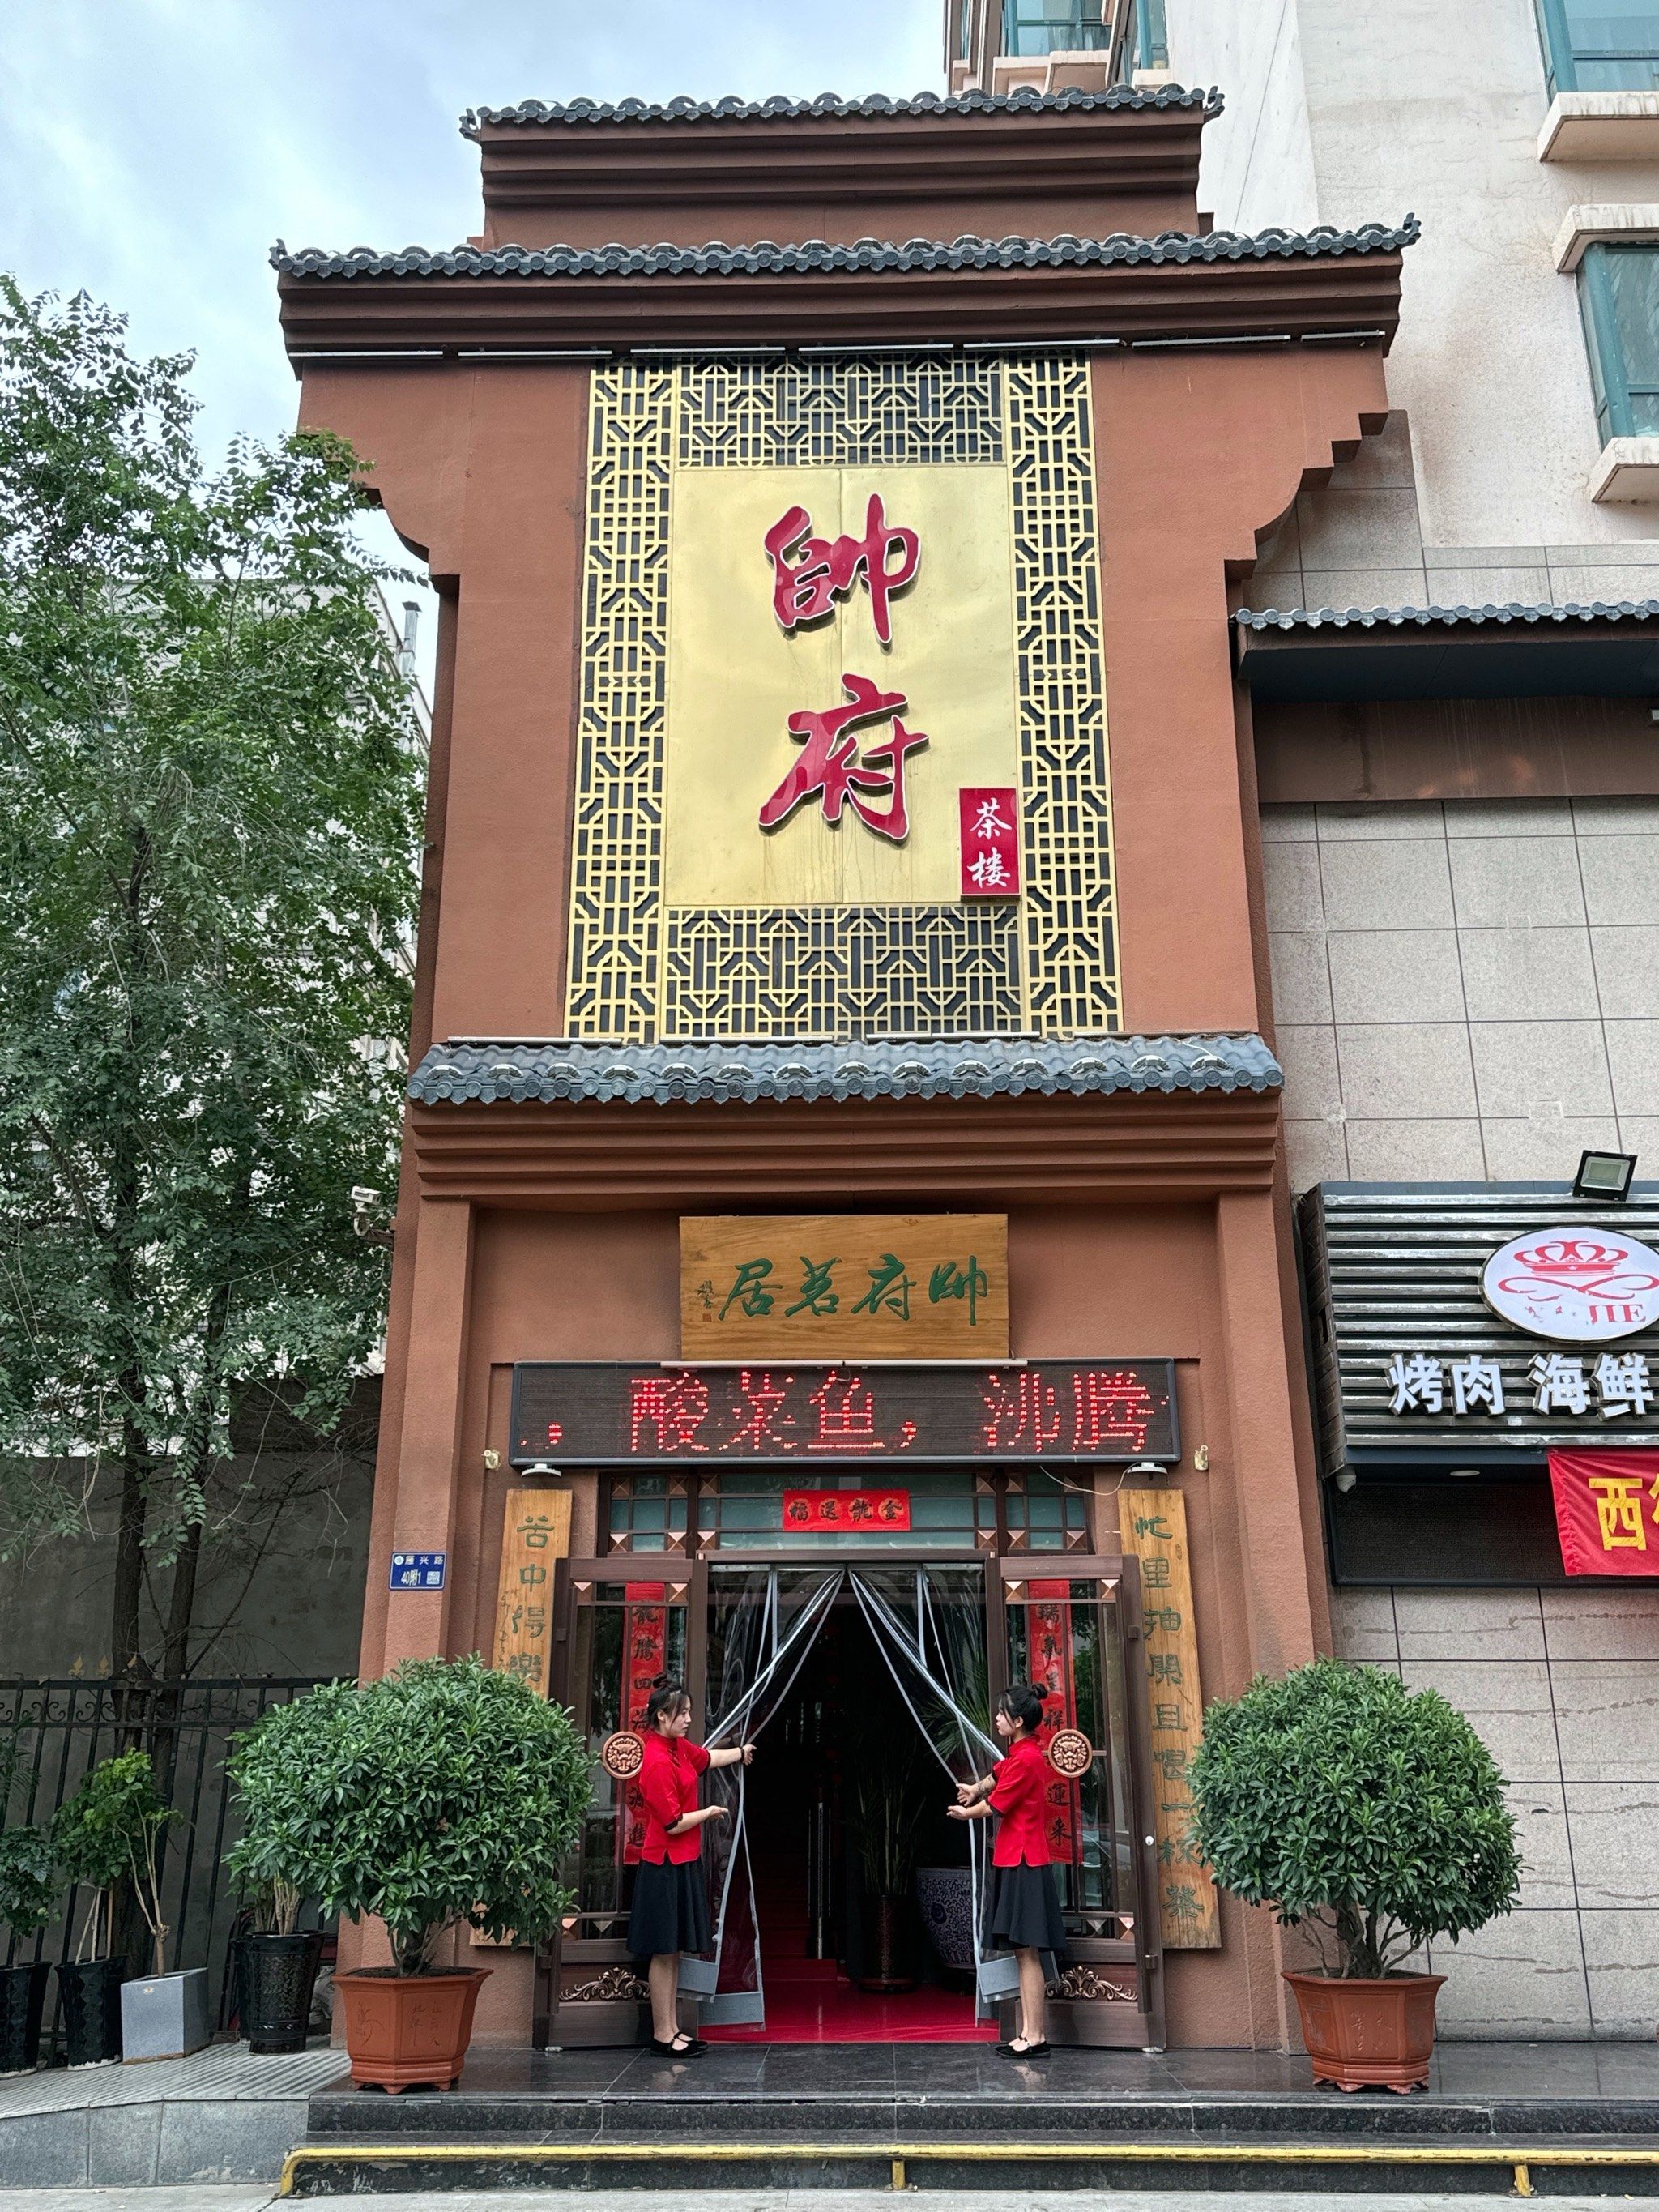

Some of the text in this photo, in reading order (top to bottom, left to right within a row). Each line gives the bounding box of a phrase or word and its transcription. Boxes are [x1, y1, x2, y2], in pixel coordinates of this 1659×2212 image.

[967, 797, 1013, 889] 茶楼
[1588, 1304, 1647, 1324] JIE
[1387, 1352, 1655, 1420] 烤肉 海鲜
[1589, 1472, 1659, 1551] 西
